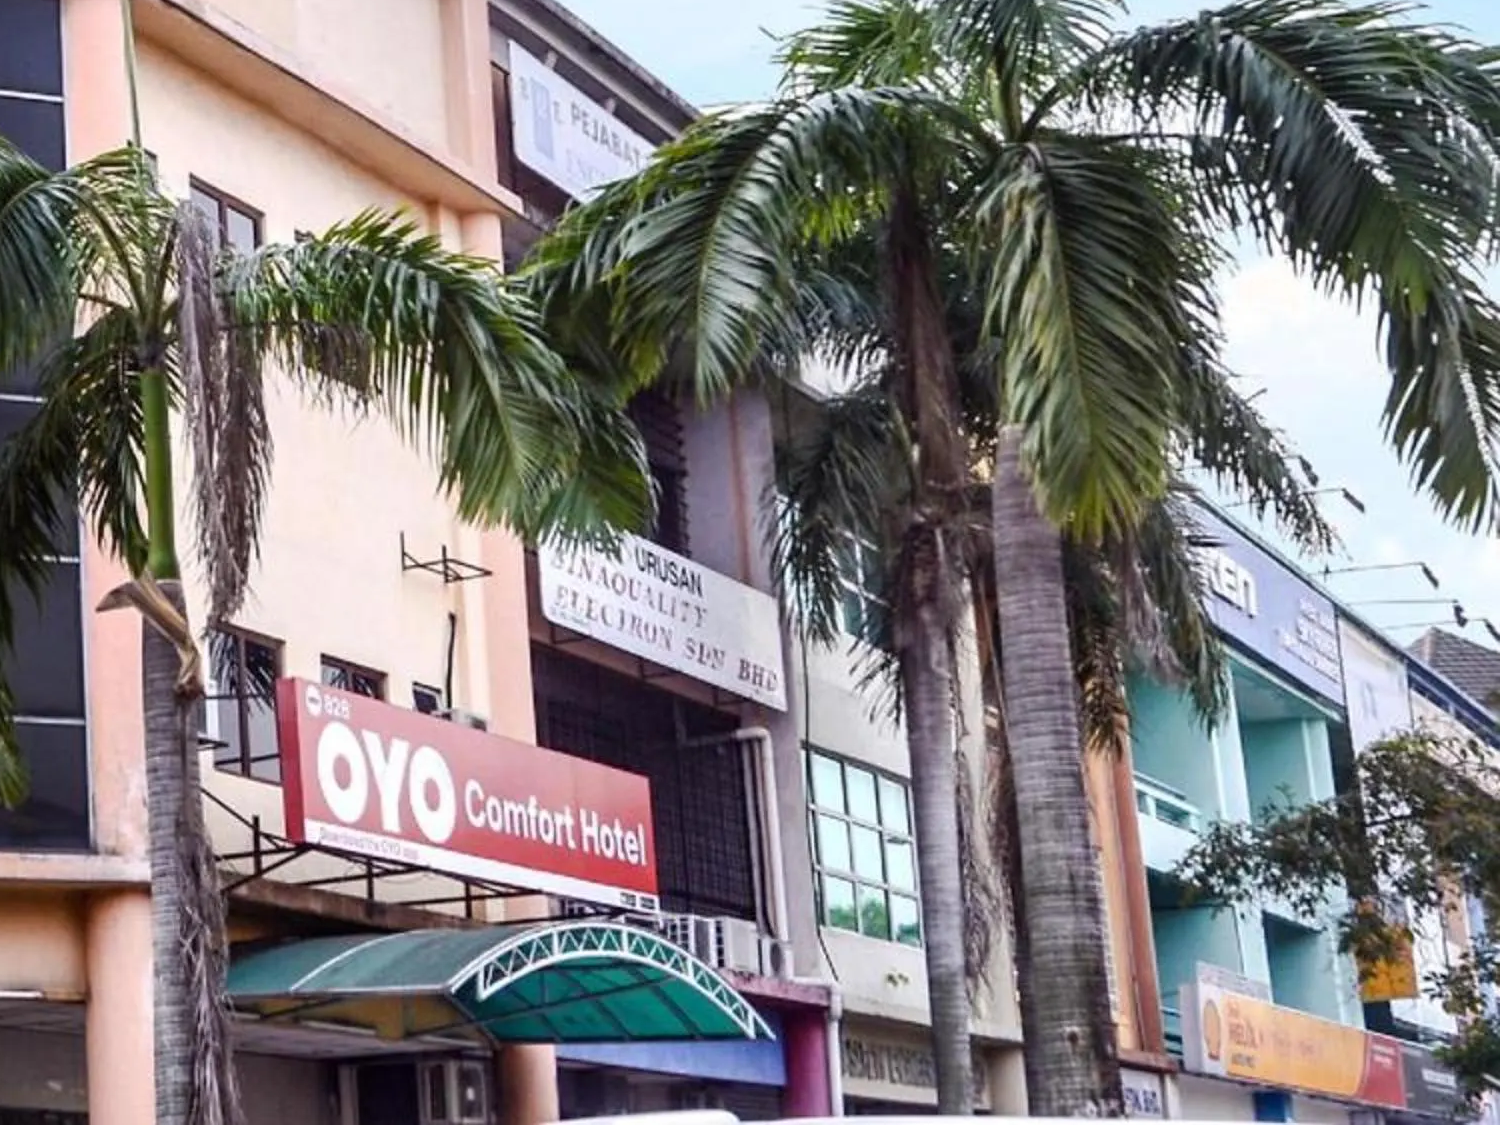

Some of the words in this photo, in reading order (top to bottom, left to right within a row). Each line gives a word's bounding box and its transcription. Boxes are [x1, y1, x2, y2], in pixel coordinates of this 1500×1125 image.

[635, 545, 704, 598] URUSAN
[317, 721, 457, 844] OYO
[465, 778, 577, 850] Comfort
[580, 807, 648, 867] Hotel
